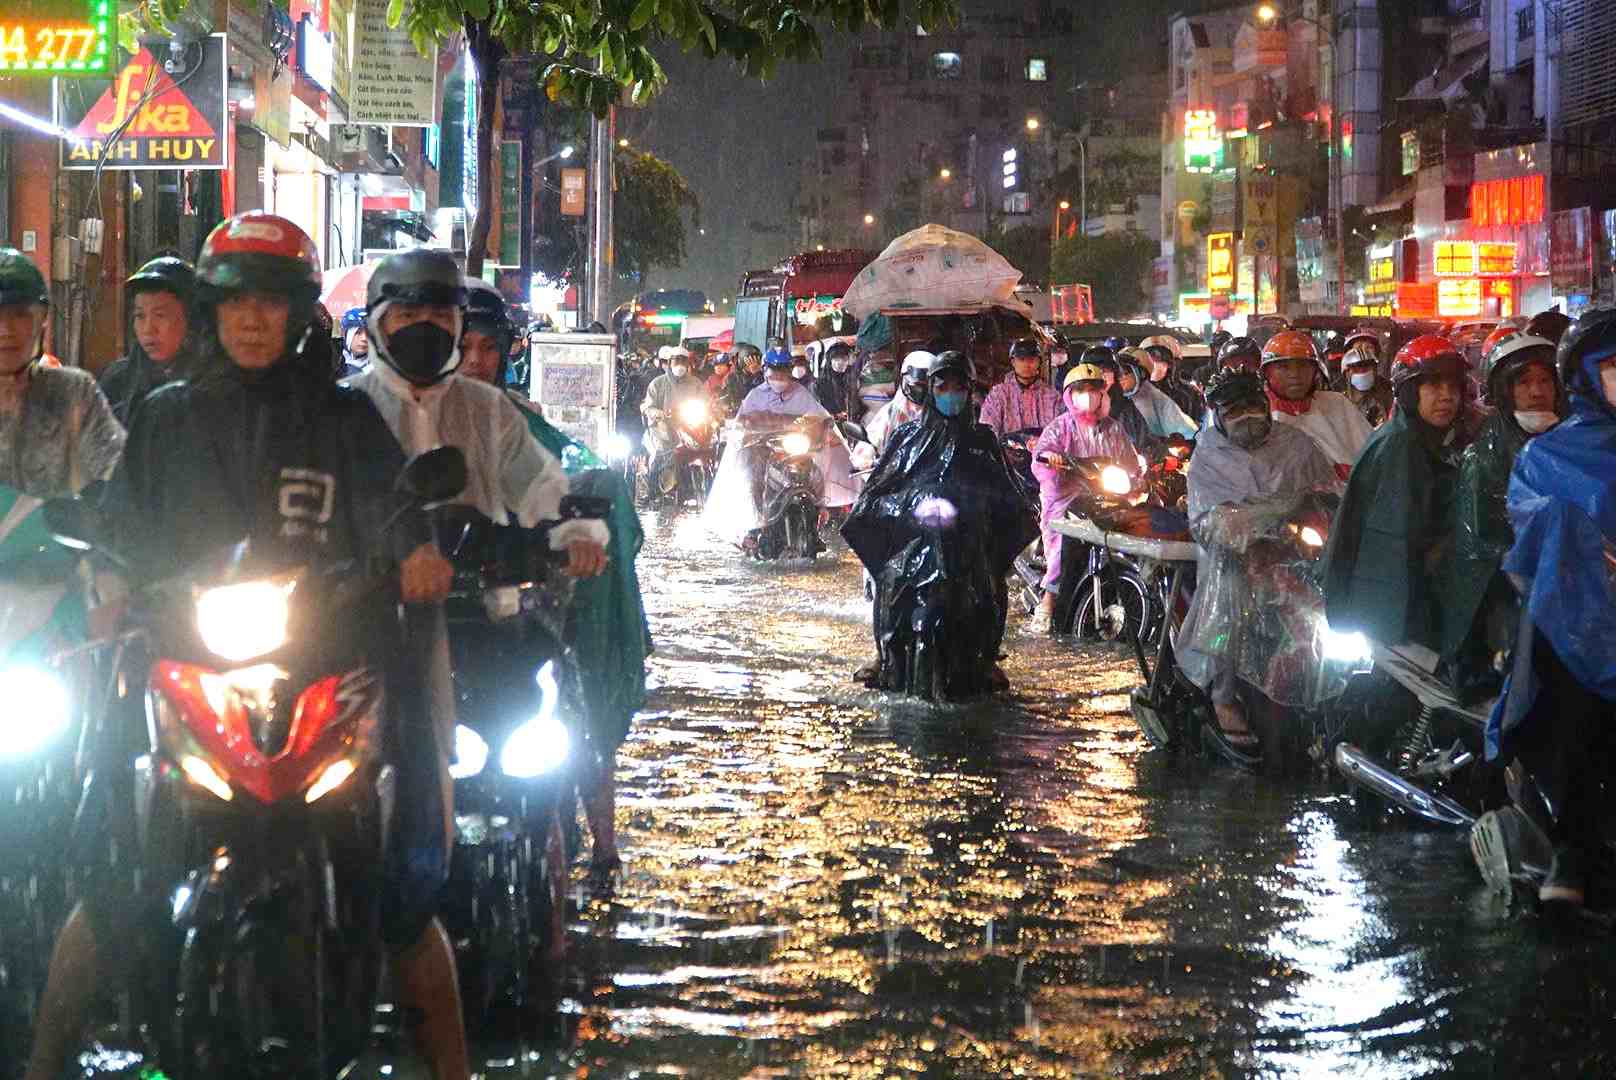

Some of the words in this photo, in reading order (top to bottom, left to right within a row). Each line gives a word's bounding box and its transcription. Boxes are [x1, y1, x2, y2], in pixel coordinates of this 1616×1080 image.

[36, 28, 96, 62] 277
[96, 64, 190, 133] Sika
[69, 138, 137, 161] ANH
[149, 138, 215, 161] HUY
